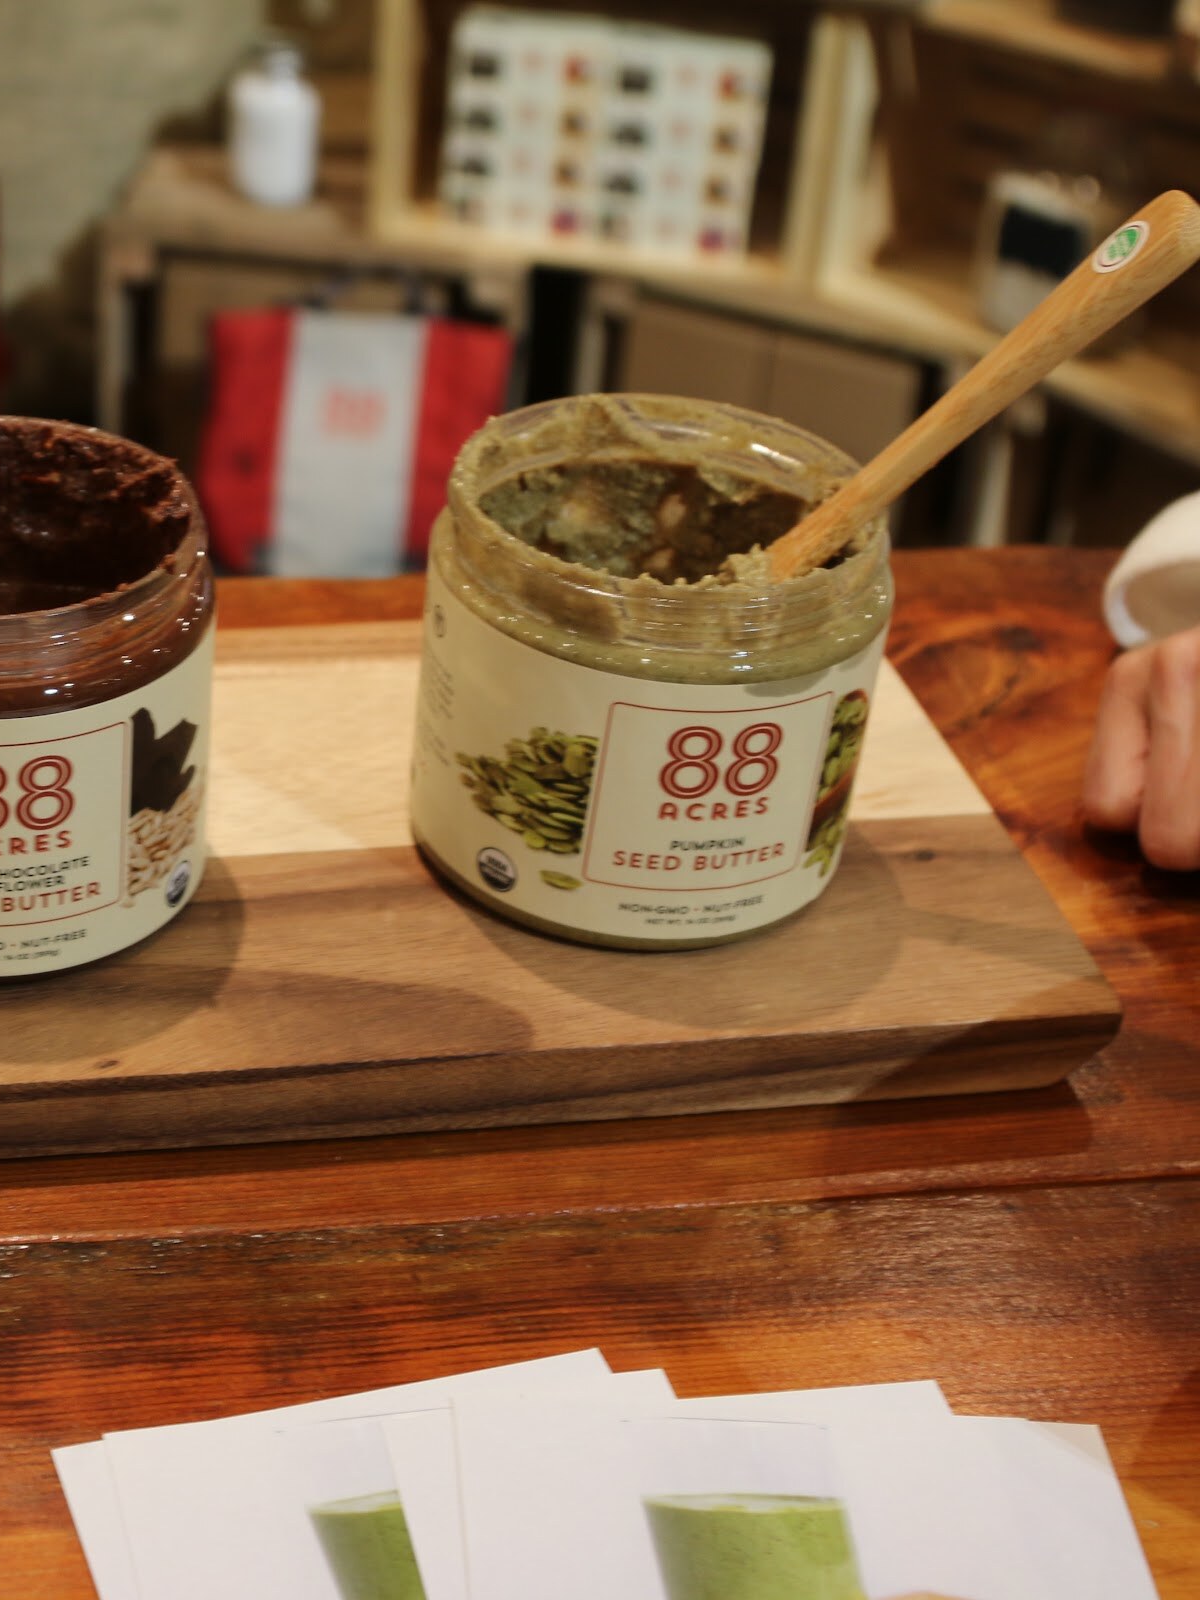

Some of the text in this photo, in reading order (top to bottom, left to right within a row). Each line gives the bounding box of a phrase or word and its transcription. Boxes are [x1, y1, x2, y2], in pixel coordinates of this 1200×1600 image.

[659, 722, 782, 799] 88
[658, 797, 769, 821] ACRES
[669, 837, 746, 851] PUMPKIN
[613, 842, 785, 871] SEED BUTTER
[1, 881, 101, 912] BUTTER
[618, 903, 689, 915] NON-GMO
[20, 928, 88, 949] NUT-FREE
